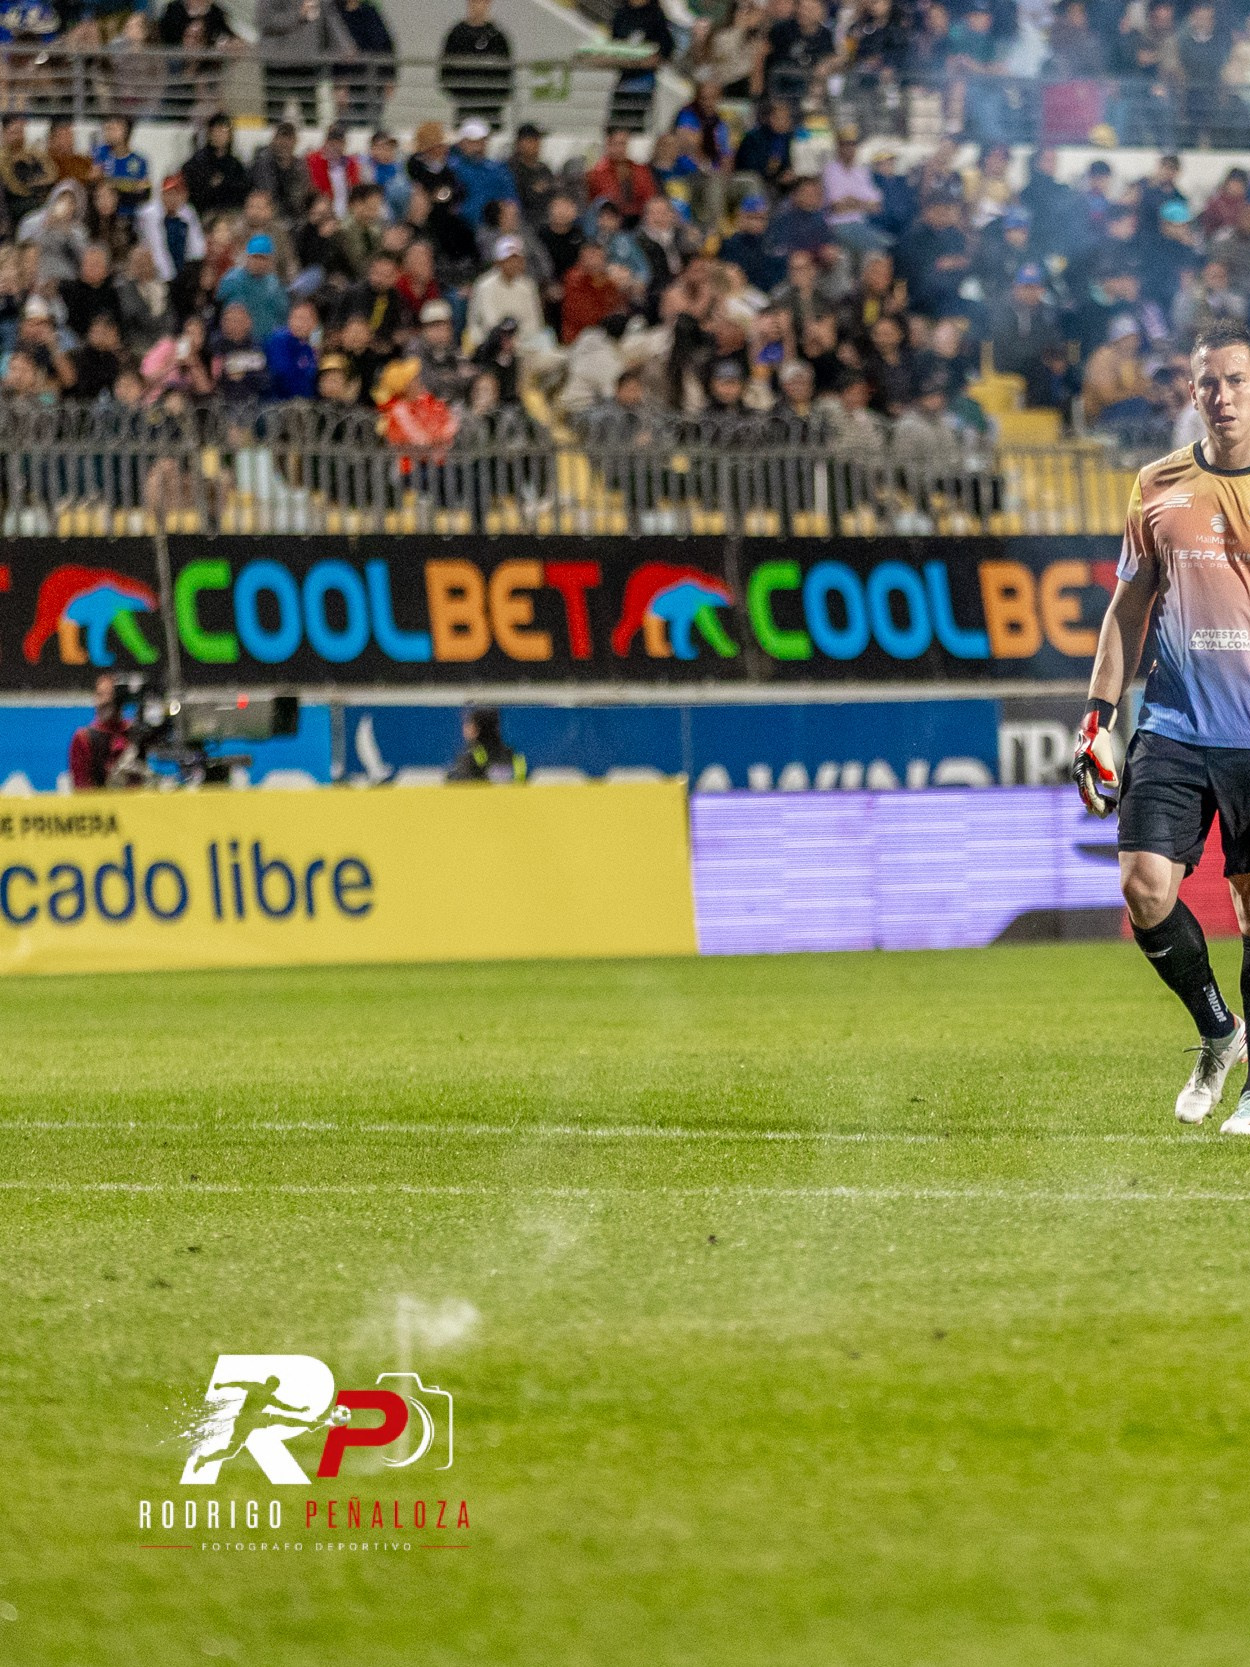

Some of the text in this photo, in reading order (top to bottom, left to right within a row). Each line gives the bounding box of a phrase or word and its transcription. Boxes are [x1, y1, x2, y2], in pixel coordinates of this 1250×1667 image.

[173, 558, 602, 664] COOLBET
[1190, 640, 1250, 649] ROYAL.COM
[1194, 631, 1248, 639] APUESTAS
[21, 813, 118, 834] PRIMERA
[207, 840, 374, 919] libre
